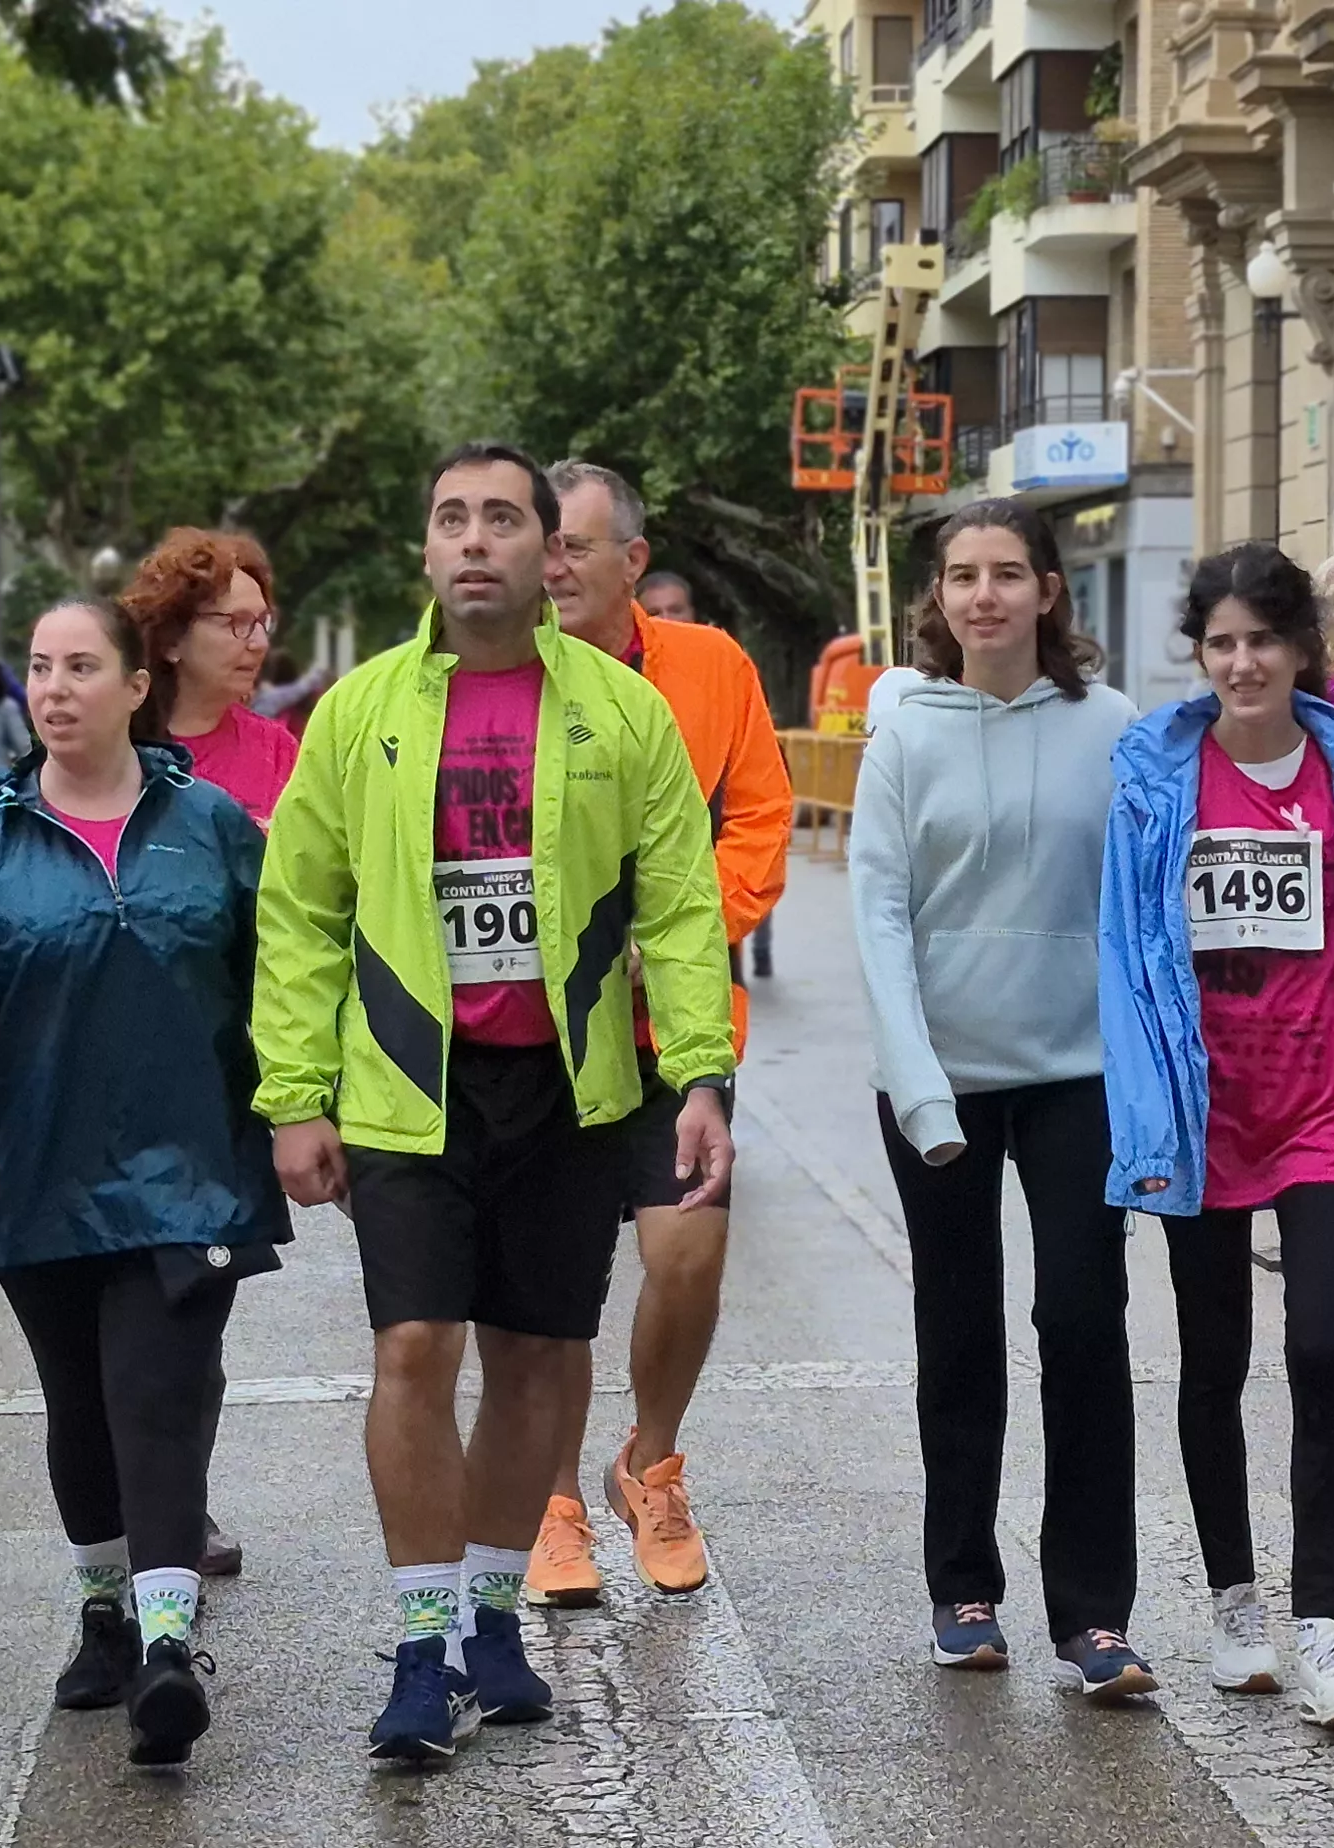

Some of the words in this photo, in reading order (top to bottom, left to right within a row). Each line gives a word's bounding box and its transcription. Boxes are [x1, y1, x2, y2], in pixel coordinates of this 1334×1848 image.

[566, 769, 613, 781] txabank
[468, 808, 501, 847] EN
[1191, 851, 1242, 866] CONTRA
[1243, 851, 1256, 862] EL
[1257, 850, 1303, 865] CÁNCER
[483, 872, 523, 883] HUESCA
[442, 885, 495, 898] CONTRA
[498, 883, 513, 895] EL
[516, 880, 533, 893] CÁ
[1192, 869, 1305, 914] 1496
[443, 901, 538, 948] 190
